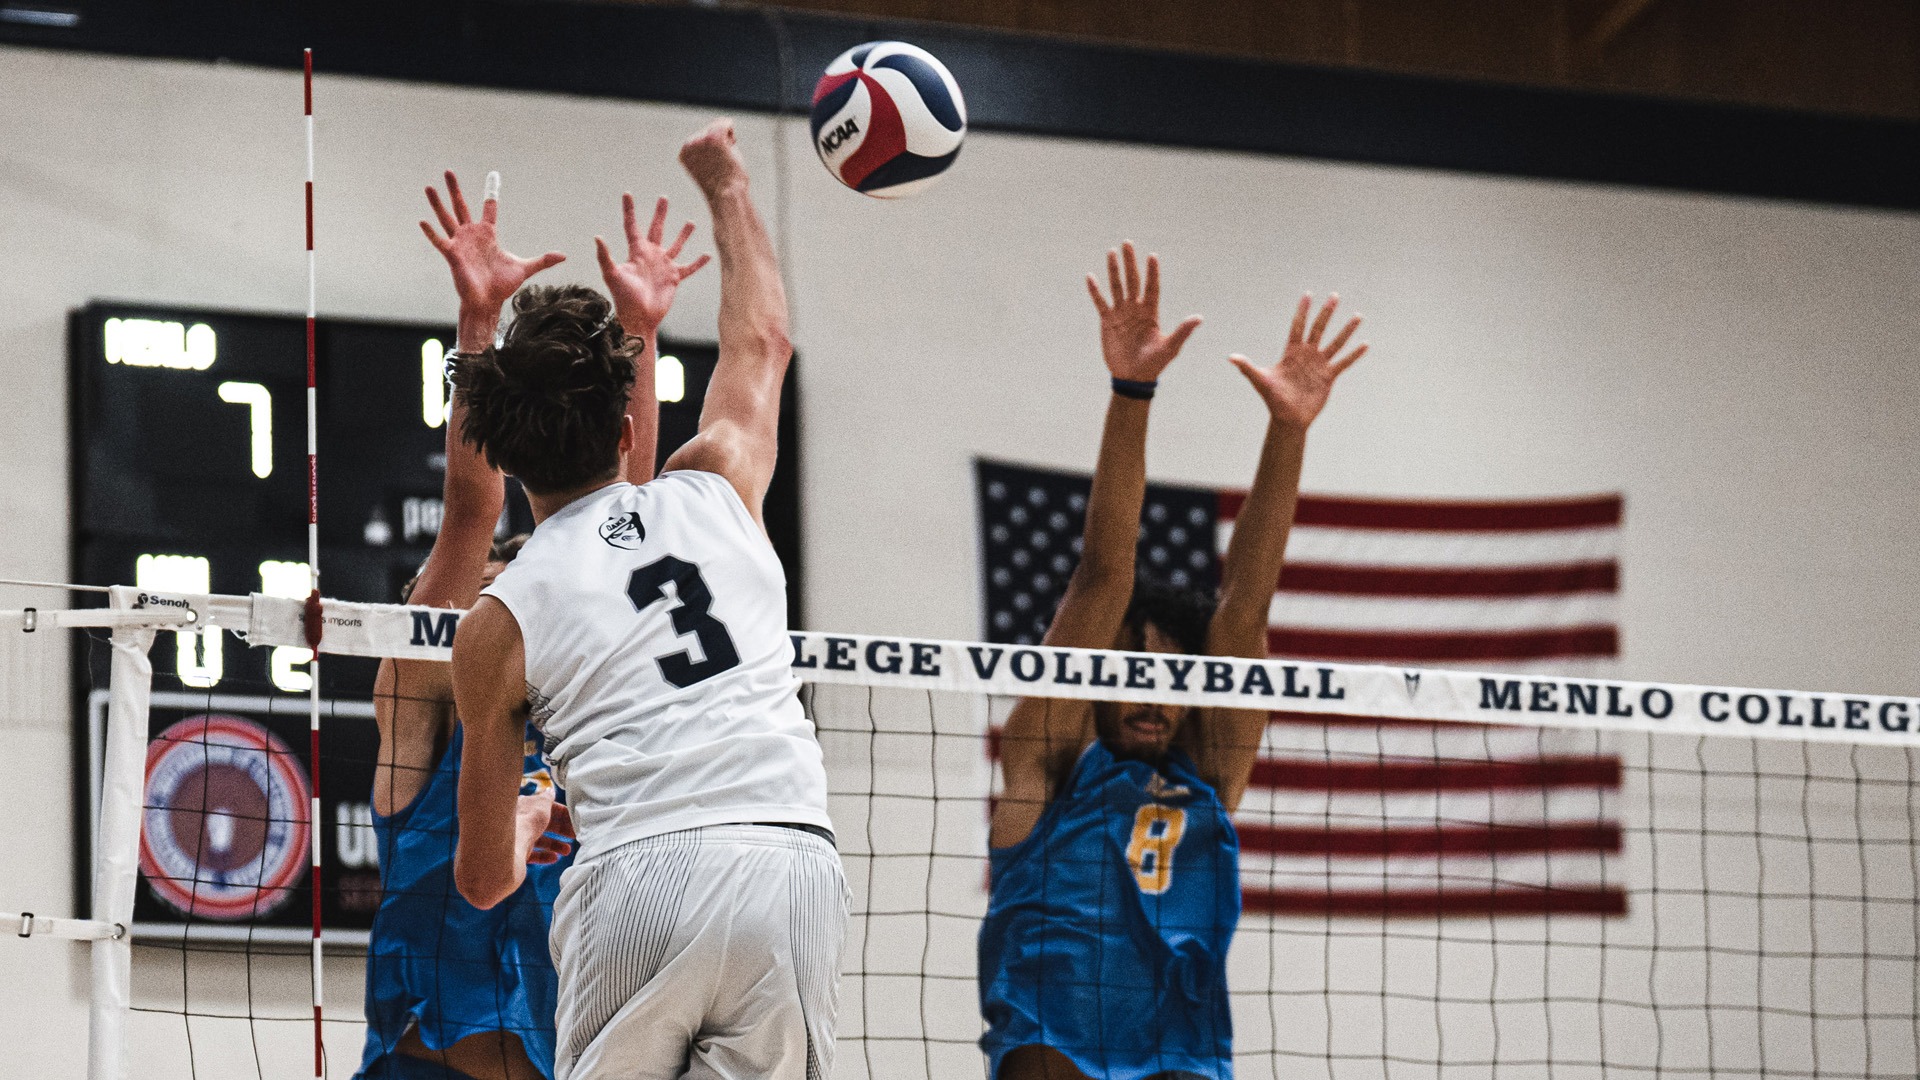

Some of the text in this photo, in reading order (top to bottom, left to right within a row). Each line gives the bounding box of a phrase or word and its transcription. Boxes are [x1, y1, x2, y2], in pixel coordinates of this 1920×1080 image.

[821, 118, 859, 153] NCAA
[218, 381, 272, 478] 7
[606, 516, 627, 532] OAKS
[150, 595, 190, 609] Senoh
[328, 616, 362, 627] imports
[624, 553, 743, 690] 3
[968, 646, 1346, 701] VOLLEYBALL
[1479, 678, 1674, 719] MENLO
[1701, 691, 1920, 732] COLLEG
[1125, 803, 1187, 895] 8
